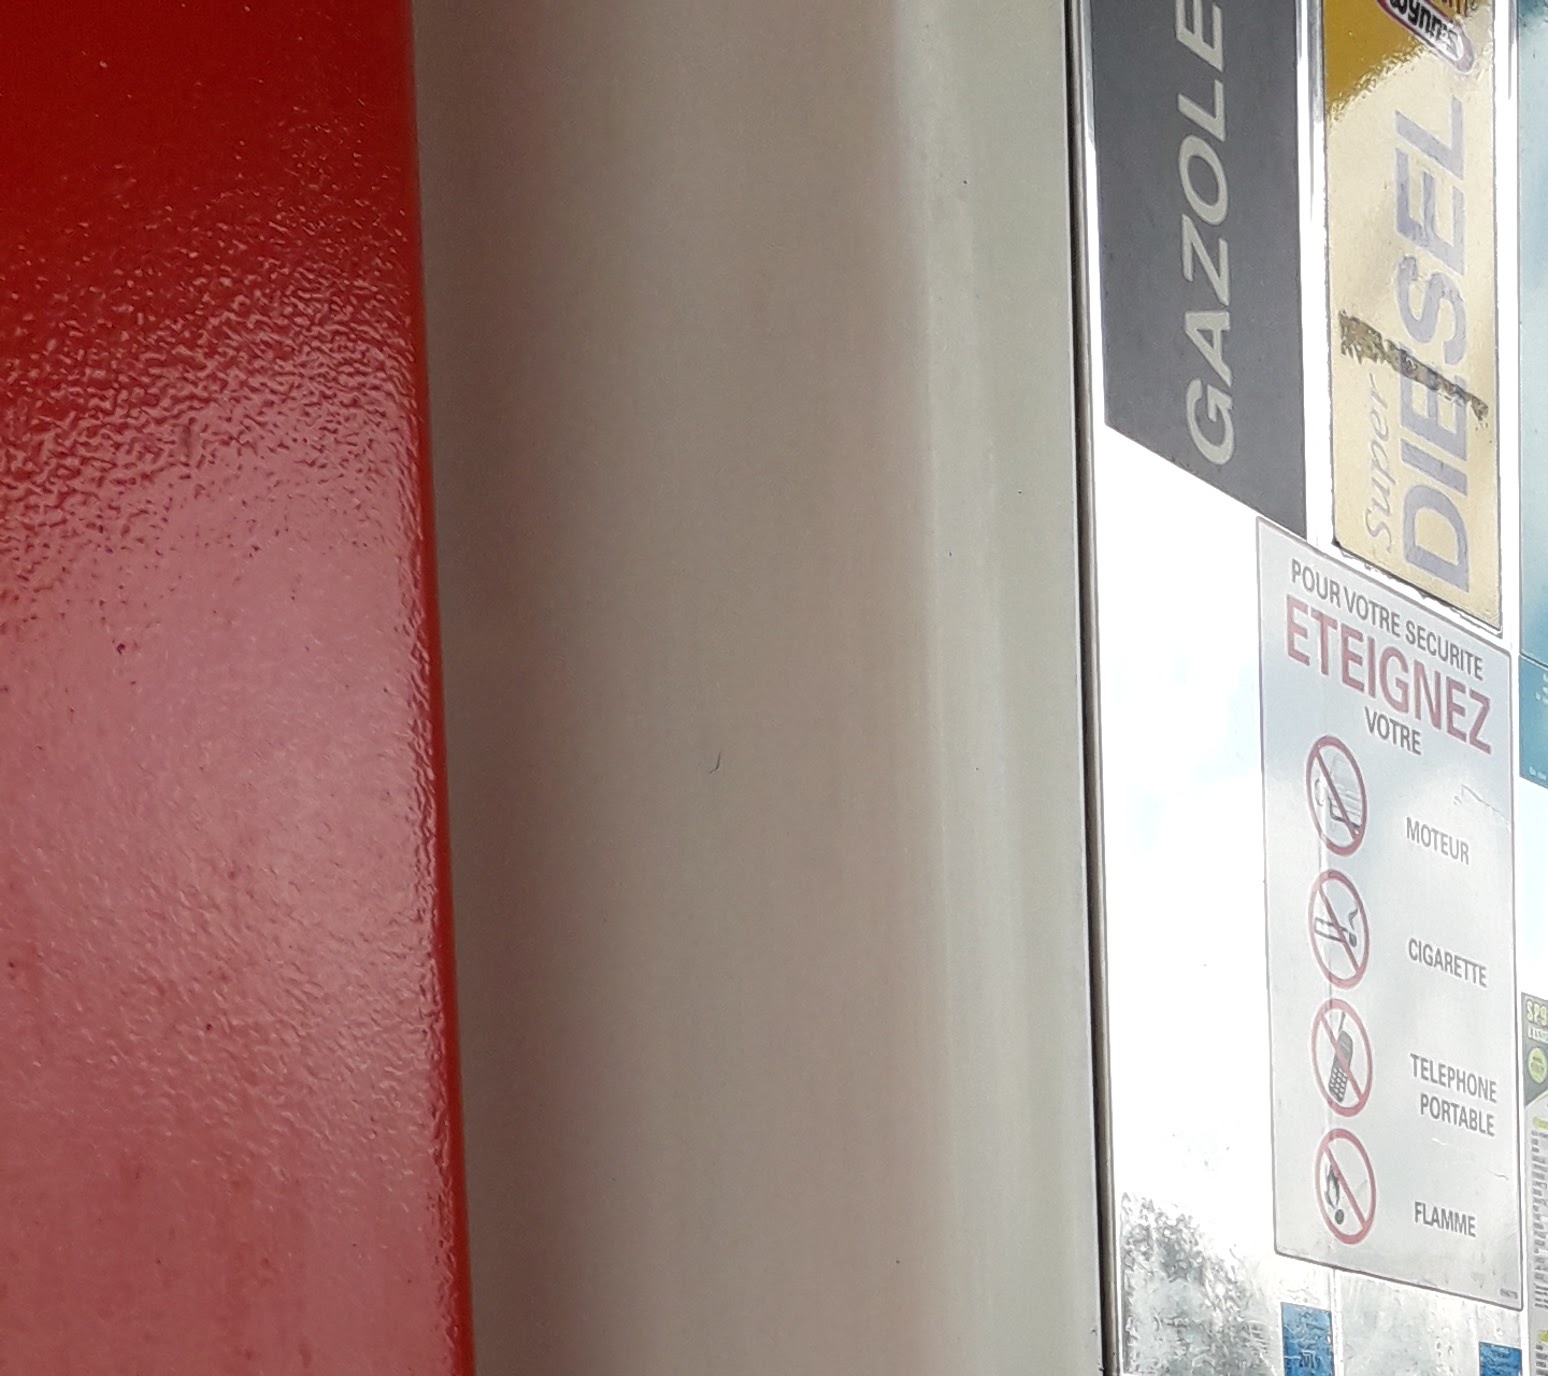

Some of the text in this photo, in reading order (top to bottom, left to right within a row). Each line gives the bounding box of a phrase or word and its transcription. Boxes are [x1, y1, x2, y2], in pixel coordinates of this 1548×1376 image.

[1176, 0, 1234, 464] GAZOLE
[1394, 97, 1470, 593] DIESEL
[1291, 558, 1484, 682] POUR VOTRE SECURITE
[1286, 593, 1492, 755] ETEIGNEZ
[1364, 705, 1422, 756] VOTRE
[1406, 816, 1470, 866] MOTEUR
[1408, 938, 1488, 988] CIGARETTE
[1410, 1053, 1497, 1103] TELEPHONE
[1420, 1093, 1495, 1137] PORTABLE
[1414, 1202, 1476, 1238] FLAMME
